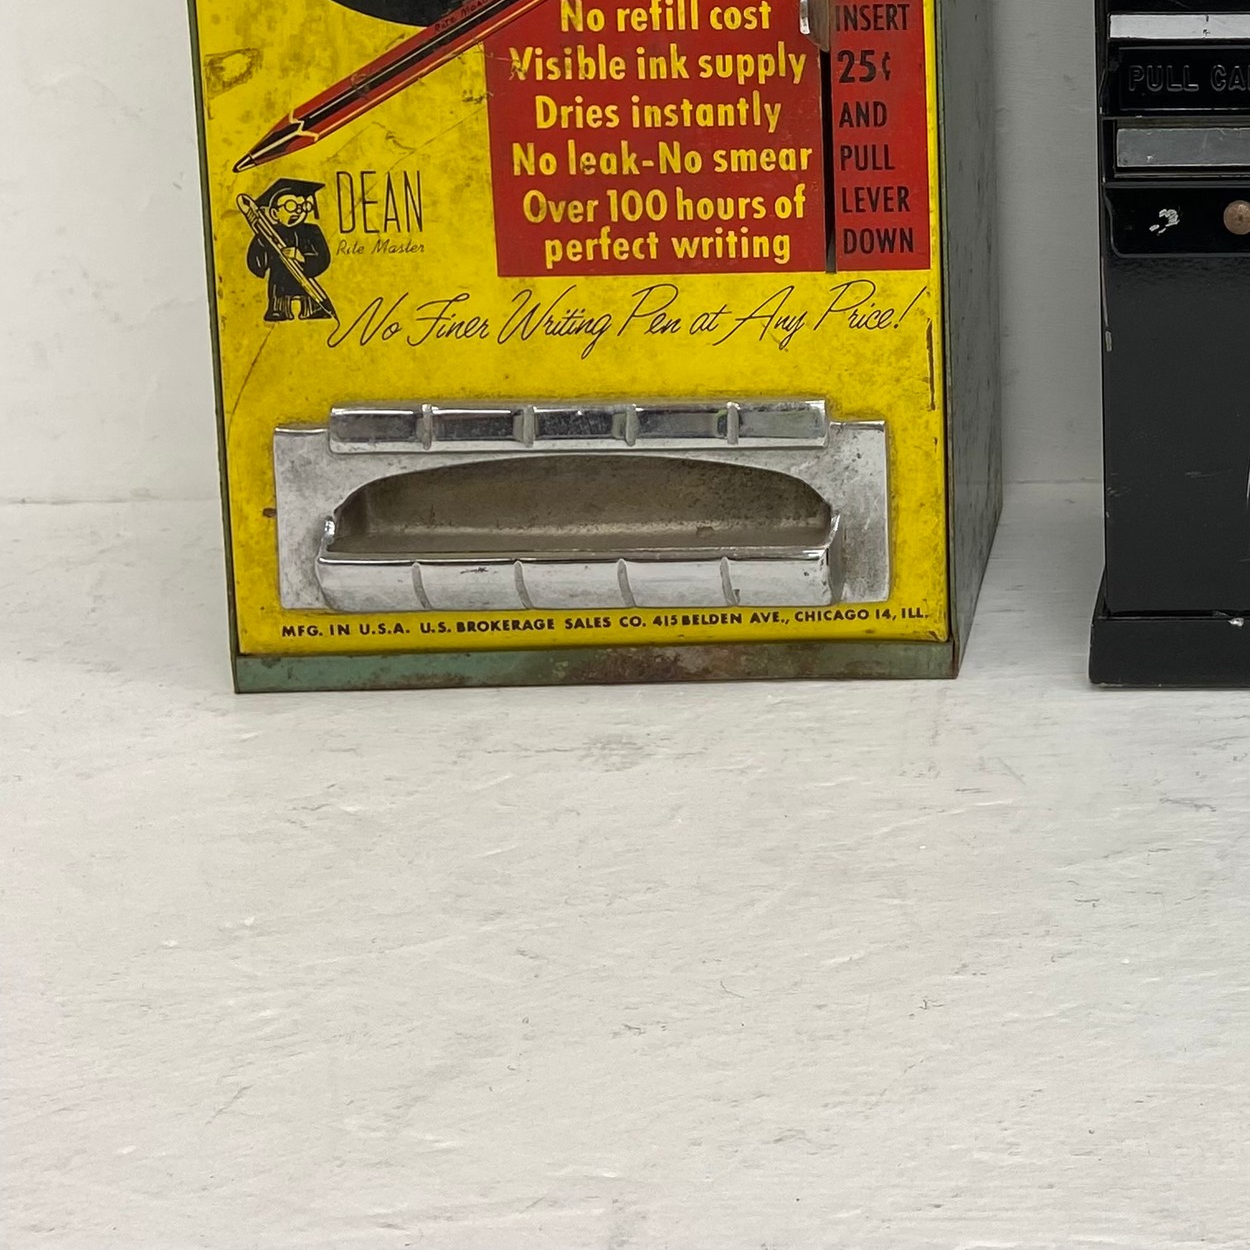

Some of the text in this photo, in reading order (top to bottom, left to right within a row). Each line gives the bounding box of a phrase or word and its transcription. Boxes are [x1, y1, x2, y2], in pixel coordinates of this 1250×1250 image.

[709, 0, 772, 30] cost
[835, 3, 910, 33] INSERT
[509, 41, 808, 85] Visible ink supply
[1128, 64, 1199, 92] PULL
[535, 90, 783, 133] Dries instantly
[839, 101, 888, 129] AND
[512, 142, 557, 176] No
[713, 144, 813, 172] smear
[840, 144, 896, 172] PULL
[336, 170, 424, 233] DEAN
[522, 183, 806, 224] Over 100 hours of
[841, 186, 911, 213] LEVER
[336, 238, 426, 256] Rite Master
[544, 226, 791, 269] perfect writing
[843, 227, 914, 255] DOWN
[327, 279, 928, 360] No Finer Writing Pen at Any Price!
[281, 624, 323, 638] MFG.
[329, 623, 351, 636] IN
[359, 622, 410, 635] U.S.A.
[419, 621, 451, 634] U.S.
[456, 618, 555, 633] BROKERAGE
[564, 617, 612, 630] SALES
[619, 616, 647, 628] CO.
[652, 614, 678, 627] 415
[681, 612, 742, 626] BELDEN
[794, 608, 870, 623] CHICAGO
[875, 607, 897, 621] 14,
[901, 607, 929, 619] ILL.
